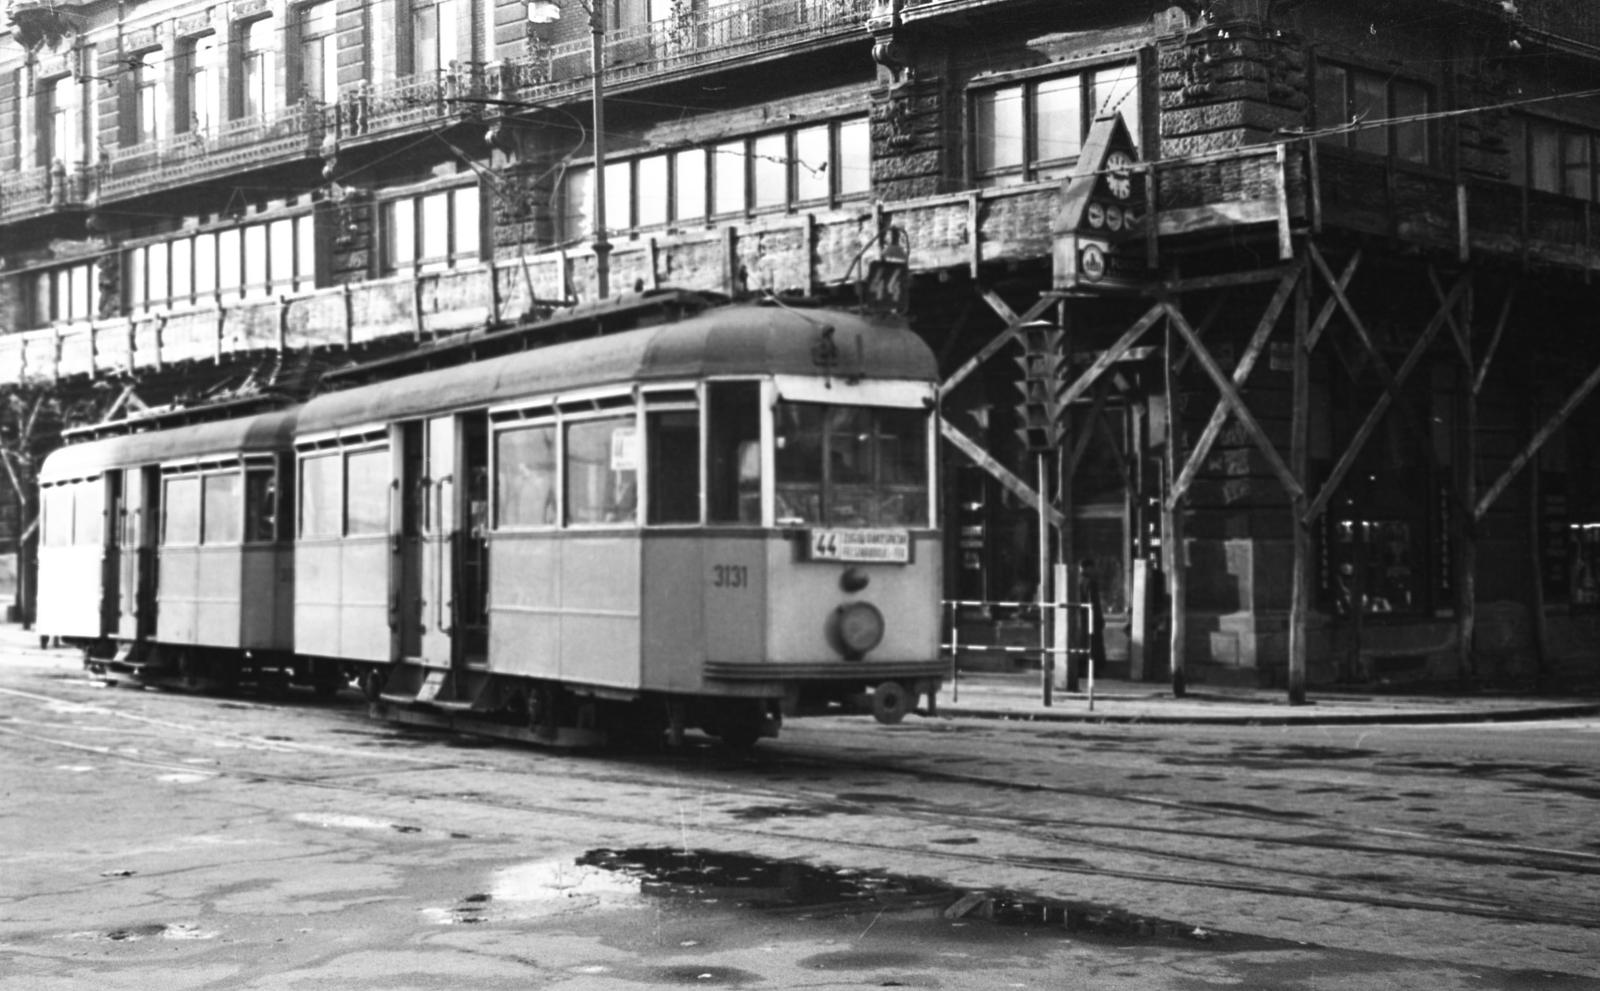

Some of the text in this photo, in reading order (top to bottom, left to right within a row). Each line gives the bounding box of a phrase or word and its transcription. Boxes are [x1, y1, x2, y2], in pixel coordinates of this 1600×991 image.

[868, 266, 901, 302] 44
[816, 533, 837, 556] 44
[713, 564, 748, 589] 3131
